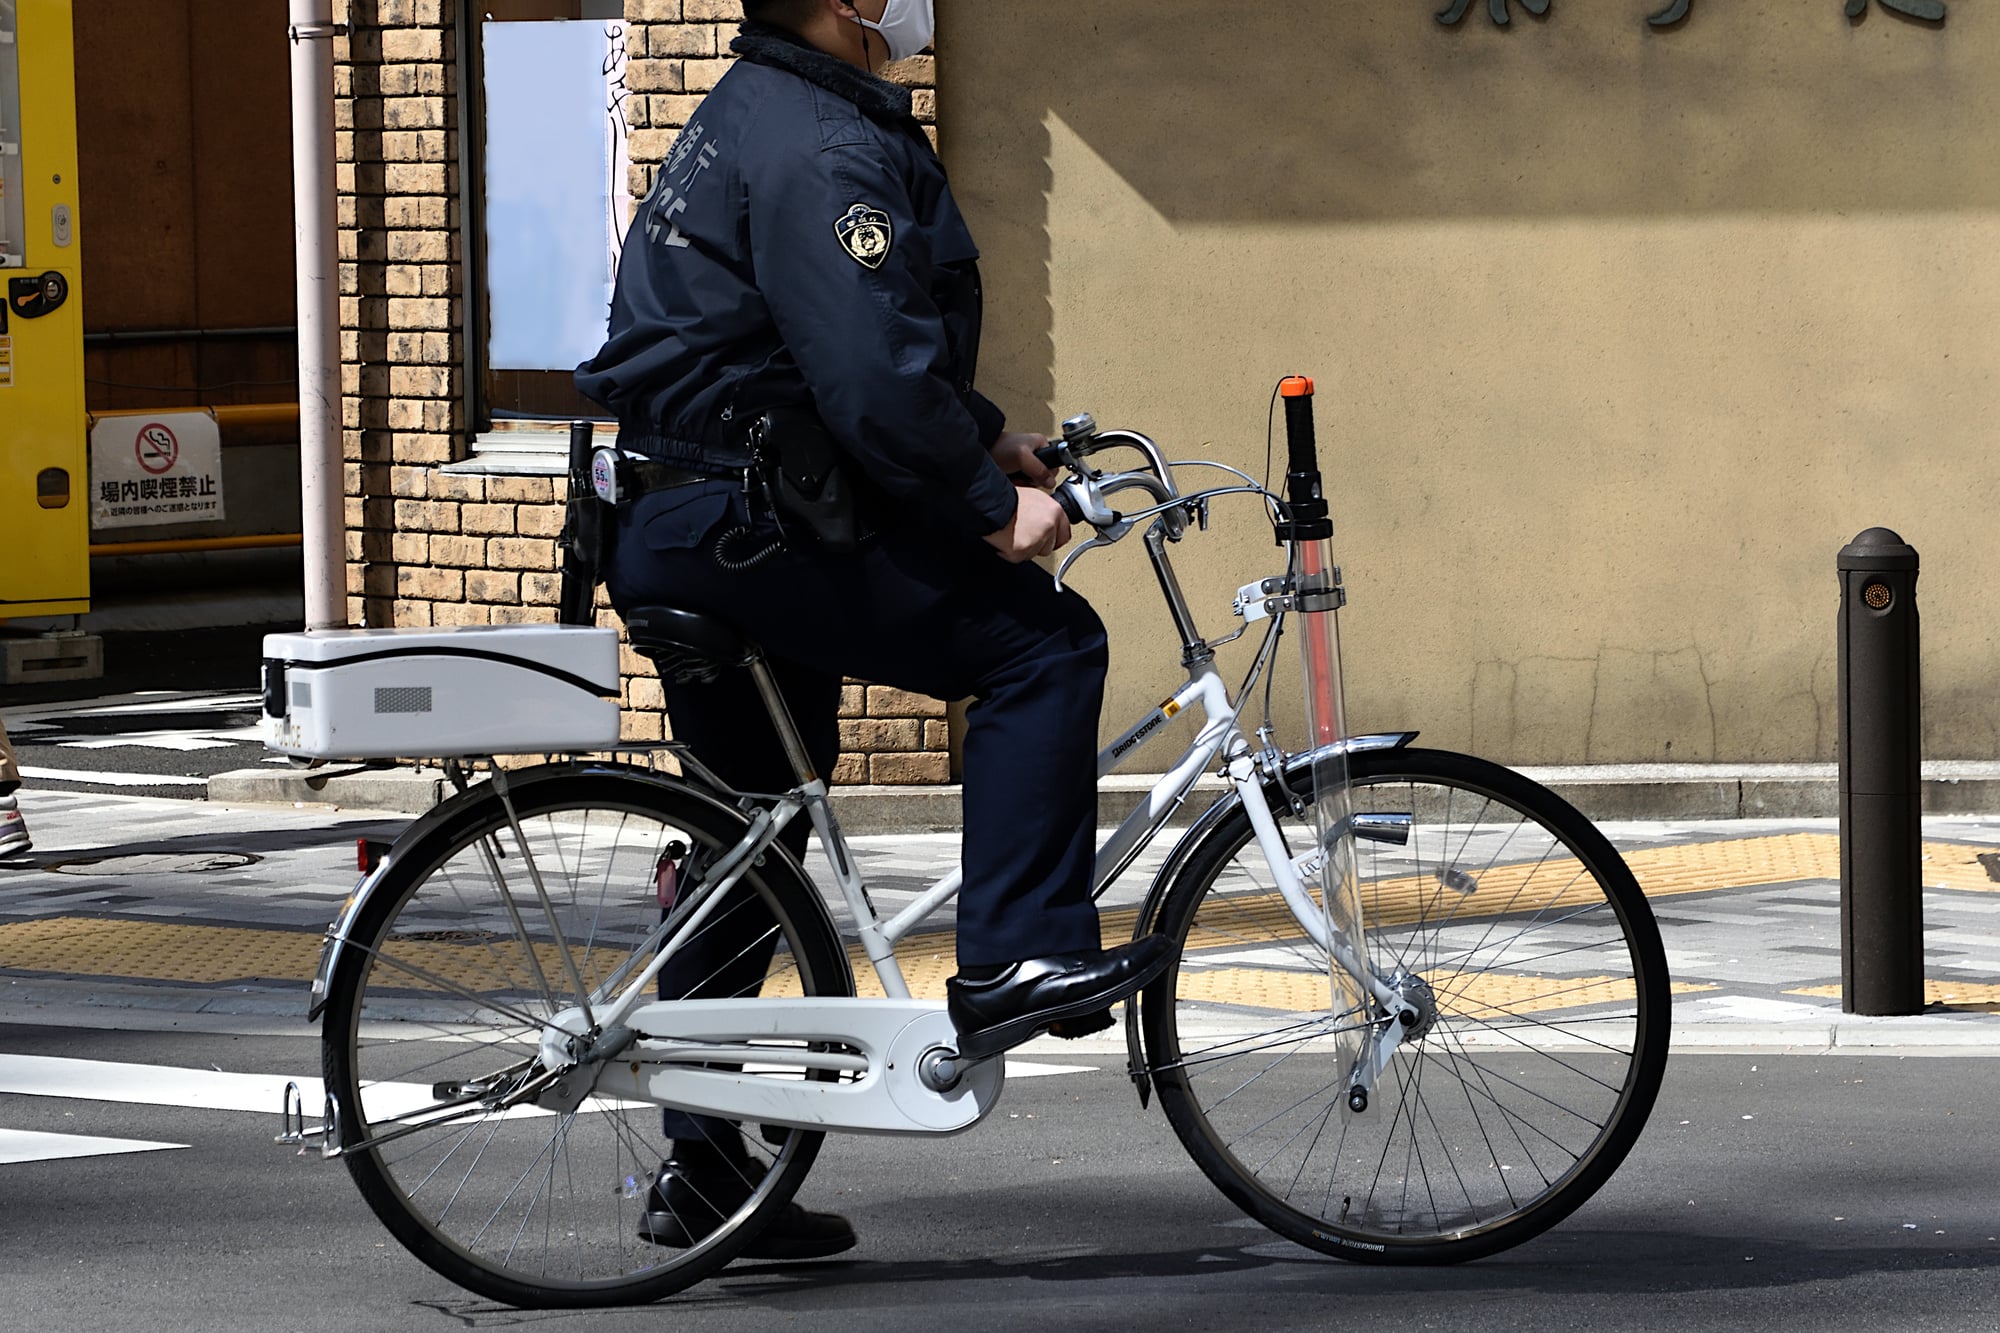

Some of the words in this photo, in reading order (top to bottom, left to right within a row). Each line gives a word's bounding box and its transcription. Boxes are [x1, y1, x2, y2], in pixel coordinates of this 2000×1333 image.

[100, 474, 217, 503] 場内喫煙禁止
[1112, 714, 1162, 758] BRIDGESTONE
